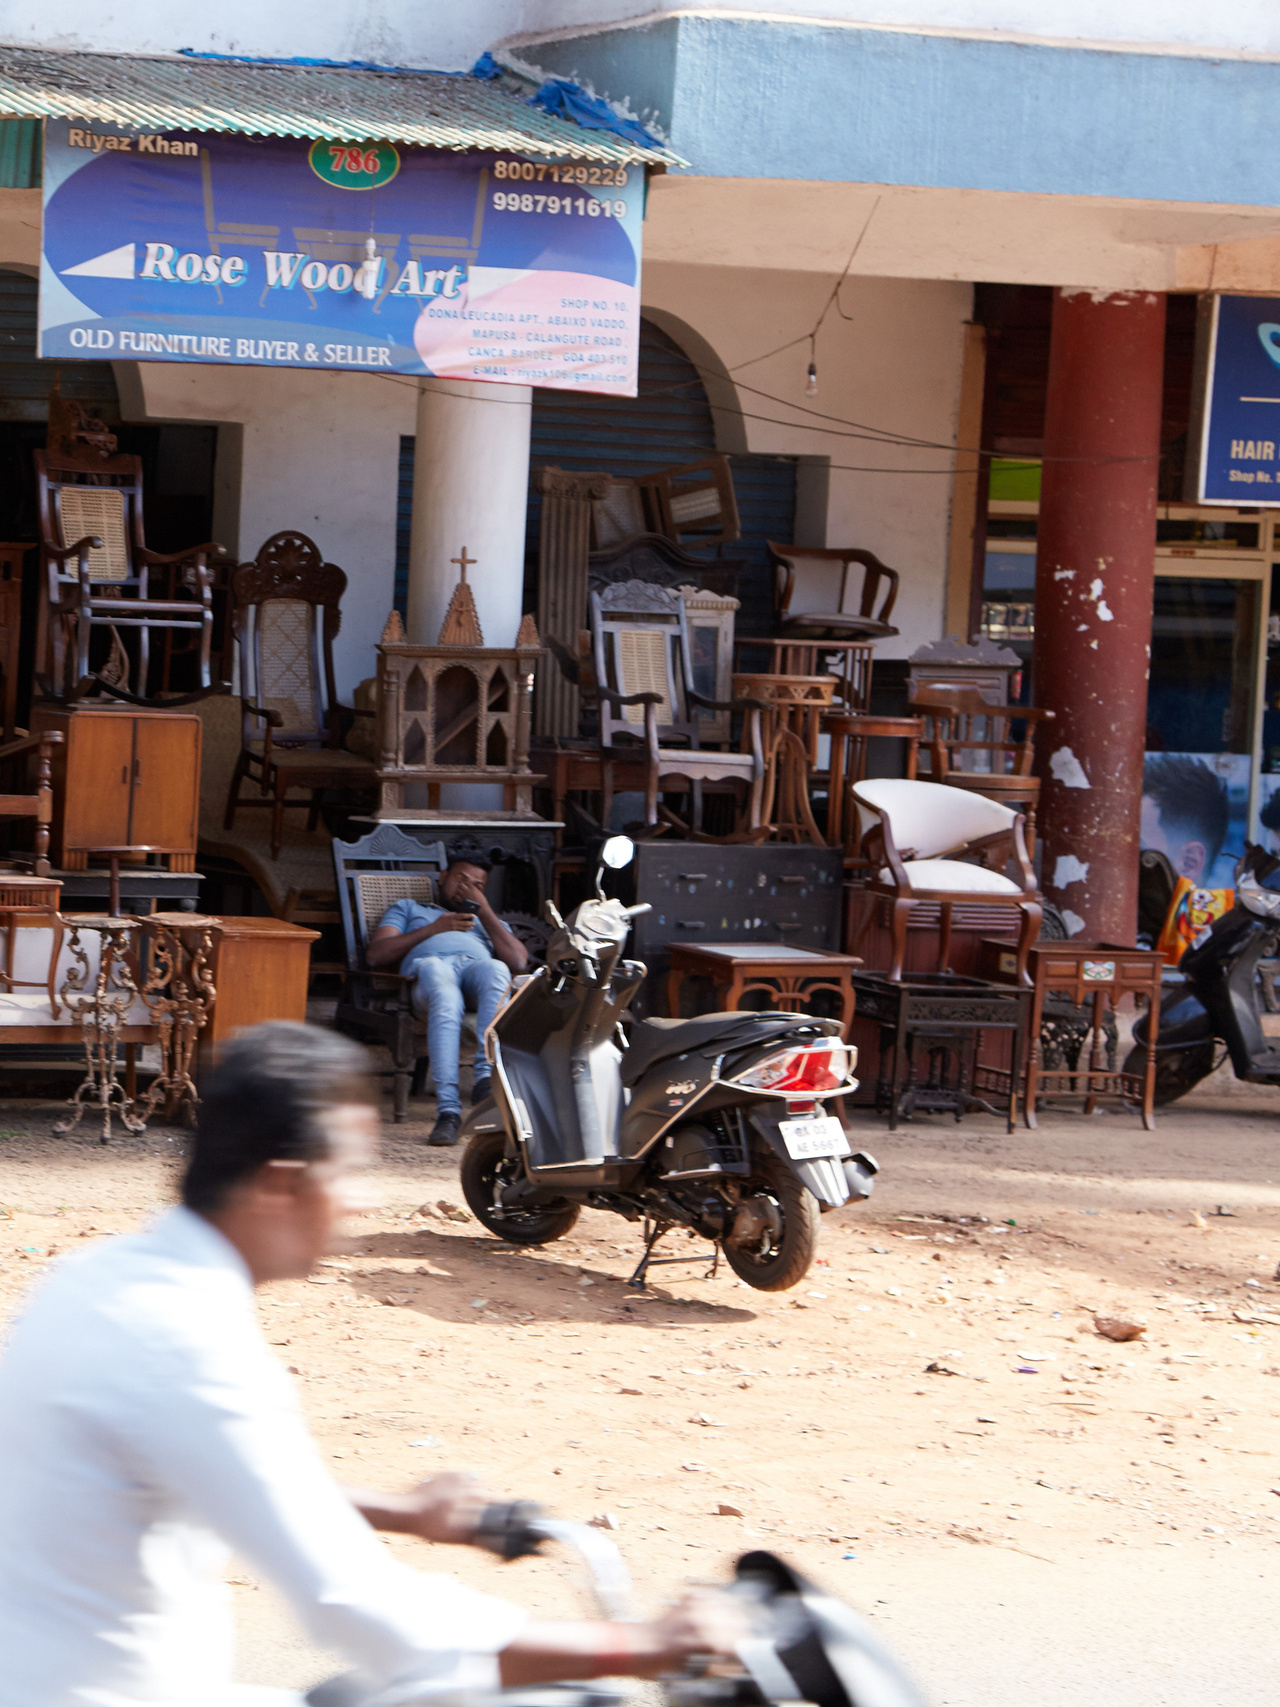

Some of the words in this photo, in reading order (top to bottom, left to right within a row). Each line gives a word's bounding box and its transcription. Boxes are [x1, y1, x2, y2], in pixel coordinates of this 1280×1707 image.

[68, 127, 133, 154] Riyaz
[137, 133, 199, 157] Khan
[328, 145, 382, 176] 786
[493, 160, 630, 188] 8007129229
[492, 191, 628, 219] 9987911619
[139, 242, 247, 287] Rose
[389, 259, 466, 300] Art
[560, 298, 590, 310] SHOP
[428, 307, 459, 320] DONA
[461, 310, 515, 324] LEUCADIA
[547, 314, 587, 328] ABAIXO
[70, 327, 114, 350] OLD
[119, 329, 231, 358] FURNITURE
[236, 337, 301, 361] BUYER
[304, 341, 319, 363] &
[323, 344, 393, 367] SELLER
[472, 328, 517, 342] MAPUSA
[526, 331, 590, 345] CALANGUTE
[593, 335, 622, 348] ROAD
[511, 349, 554, 363] BARDEZ
[563, 352, 585, 364] GOA
[473, 365, 509, 378] E-MAIL
[1231, 439, 1275, 461] HAIR
[1229, 469, 1255, 484] Shop
